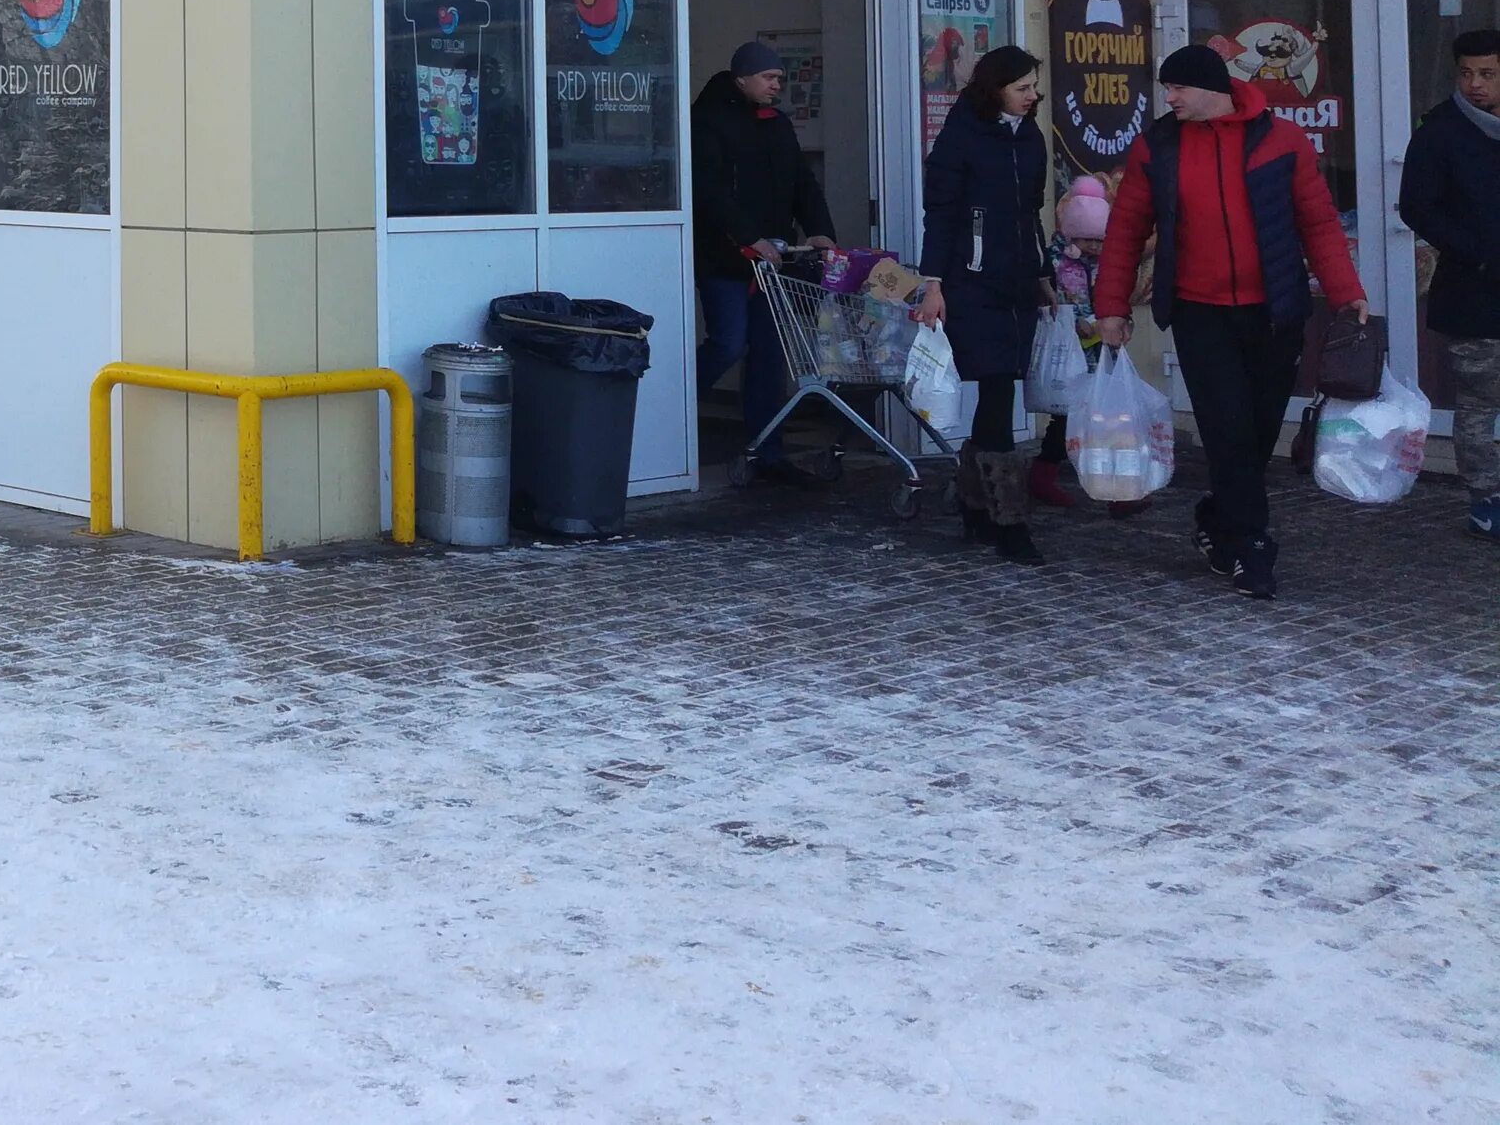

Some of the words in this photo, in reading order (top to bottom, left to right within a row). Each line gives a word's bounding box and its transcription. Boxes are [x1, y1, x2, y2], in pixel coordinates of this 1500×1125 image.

[1064, 24, 1145, 65] ГОРЯЧИЙ
[0, 64, 28, 95] RED
[33, 63, 98, 95] YELLOW
[557, 70, 587, 101] RED
[592, 70, 651, 102] YELLOW
[1083, 72, 1131, 105] ХЛЕБ
